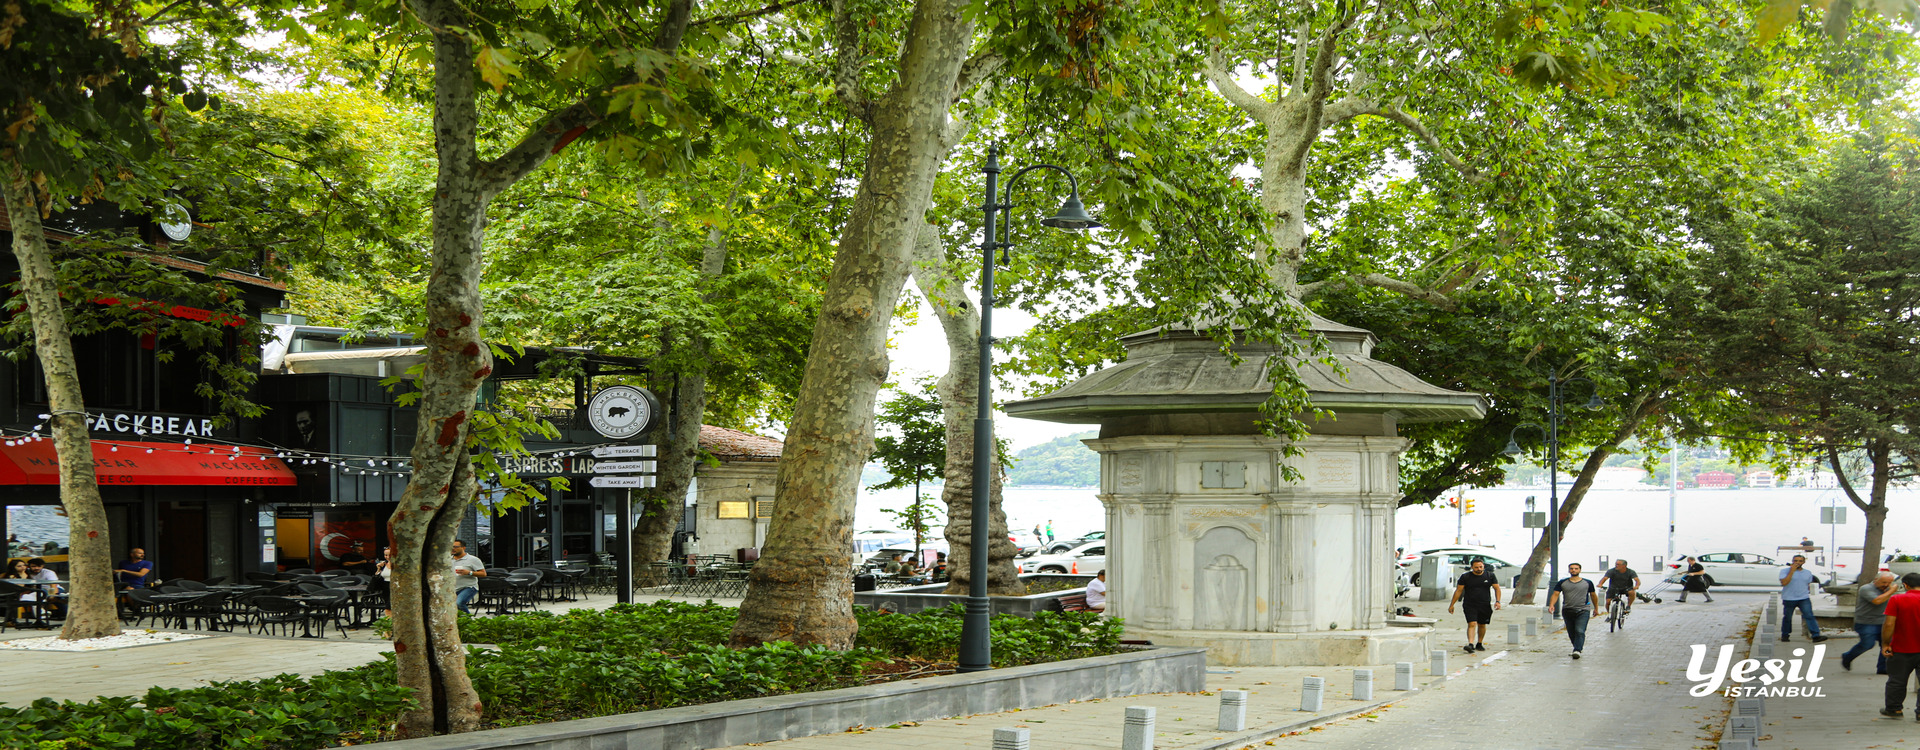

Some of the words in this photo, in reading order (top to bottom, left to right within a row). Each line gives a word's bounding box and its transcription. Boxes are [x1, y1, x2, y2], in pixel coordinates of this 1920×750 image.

[600, 391, 641, 406] MACKBEAR
[86, 413, 213, 436] ACKBEAR
[597, 418, 624, 433] COFFEE
[27, 457, 138, 468] MAEAR
[199, 462, 281, 471] MACKBEAR
[224, 476, 264, 484] COFFEE
